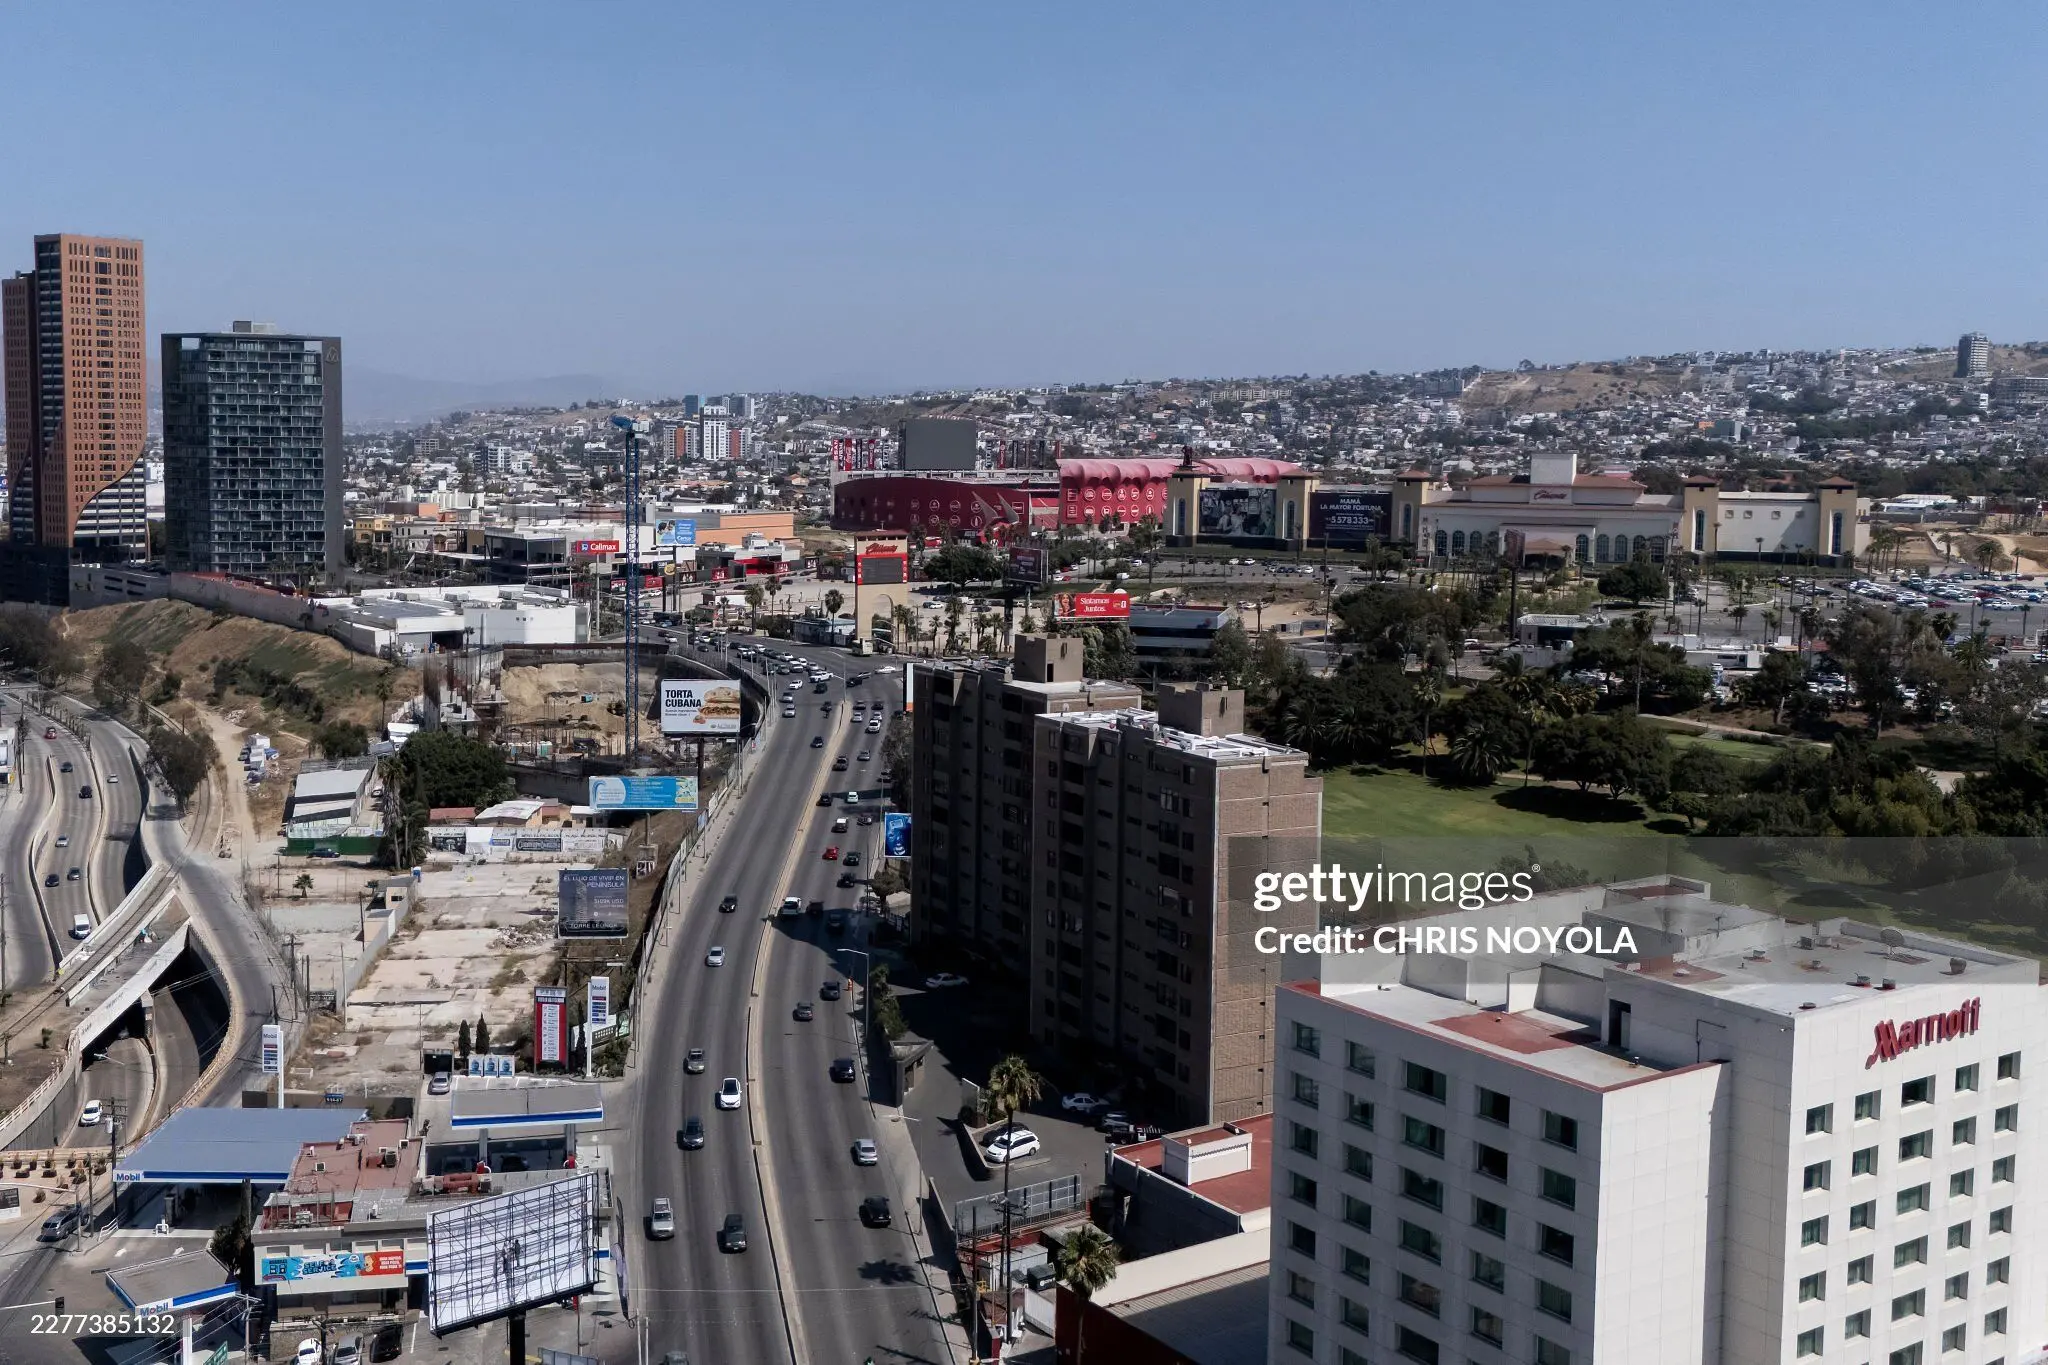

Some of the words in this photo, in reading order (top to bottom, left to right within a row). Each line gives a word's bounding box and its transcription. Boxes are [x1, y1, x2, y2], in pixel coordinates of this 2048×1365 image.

[665, 689, 693, 698] TORTA
[665, 698, 702, 708] CUBANA
[1865, 996, 1980, 1070] Marriott
[116, 1173, 140, 1181] Mobil
[140, 1301, 169, 1317] Mobil
